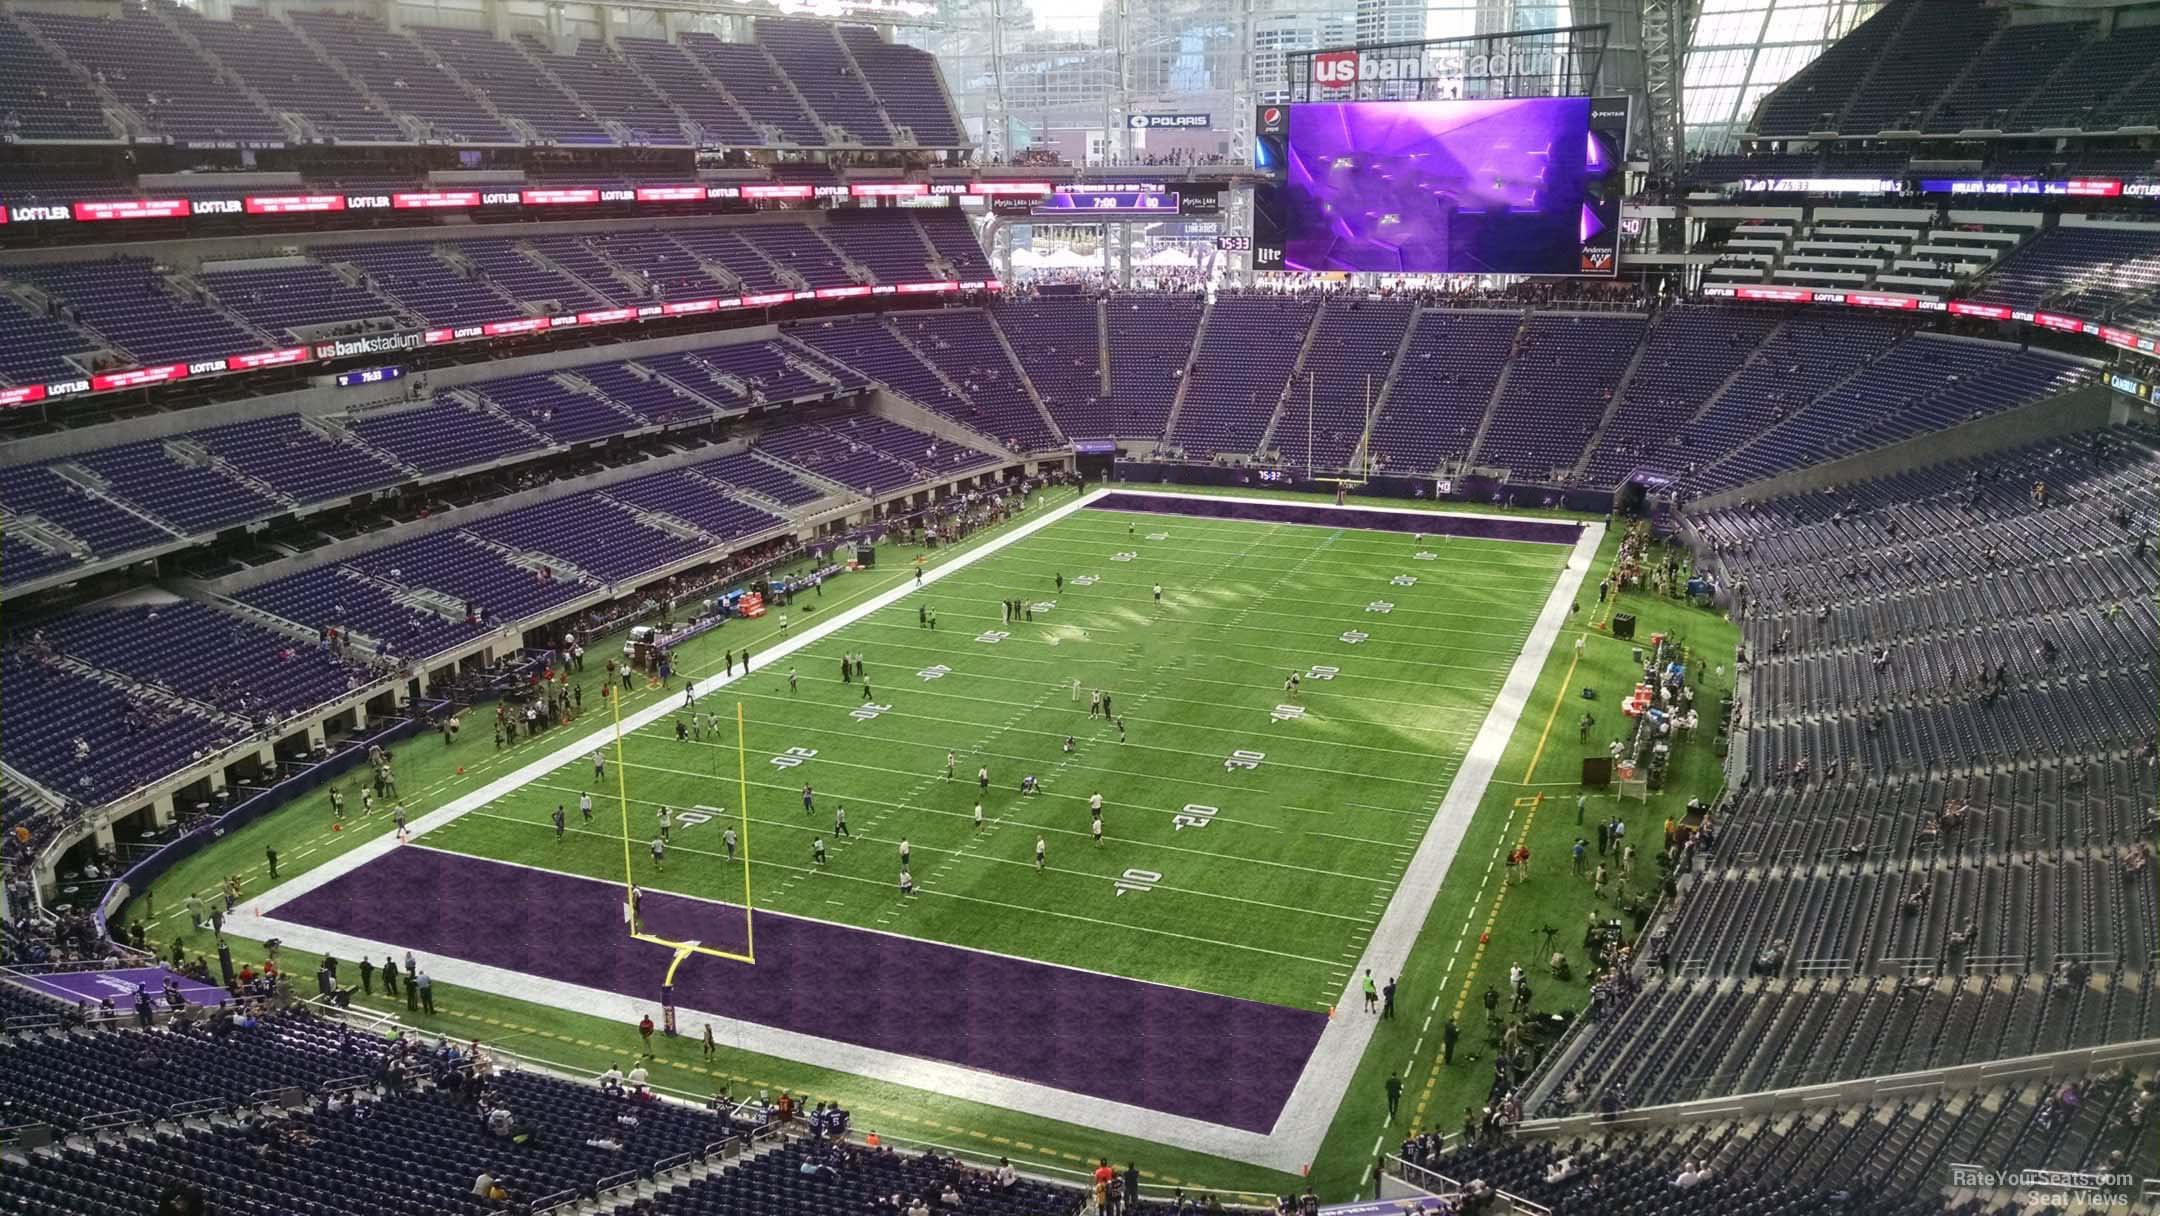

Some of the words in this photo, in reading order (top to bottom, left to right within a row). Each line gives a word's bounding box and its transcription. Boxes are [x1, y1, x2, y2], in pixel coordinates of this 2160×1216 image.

[1151, 116, 1207, 127] POLARIS
[348, 196, 390, 208] LOFFLER
[482, 193, 519, 204] LOFFLER
[12, 206, 70, 222] LOFFLER
[193, 200, 242, 214] LOFFLER
[1622, 220, 1639, 233] 40
[1219, 237, 1249, 249] 75:33
[1583, 246, 1612, 254] Andersen
[1258, 247, 1281, 263] Lite
[190, 359, 227, 374] LOFFLER
[48, 381, 90, 396] LOFFLER
[1172, 803, 1219, 828] 20
[1113, 868, 1162, 892] 10
